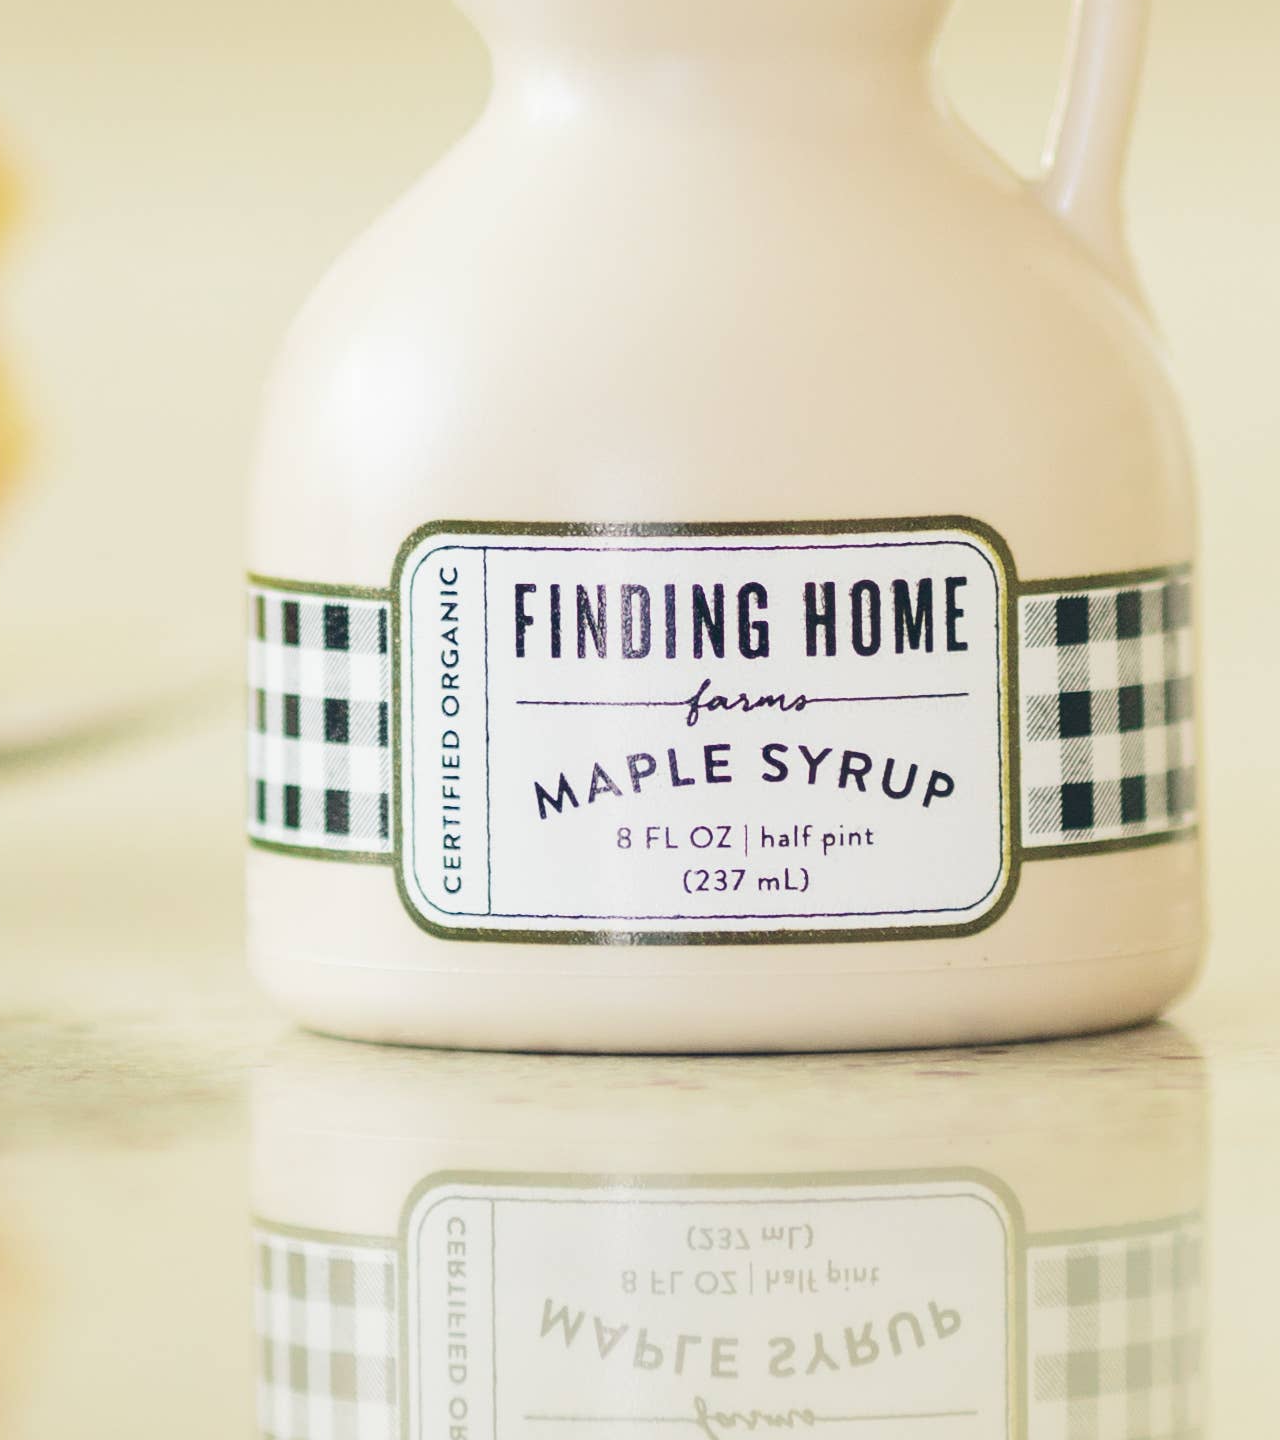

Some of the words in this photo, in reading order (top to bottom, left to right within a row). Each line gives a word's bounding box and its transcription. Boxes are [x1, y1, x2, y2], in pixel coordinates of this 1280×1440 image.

[440, 568, 459, 717] ORGANIC
[515, 582, 769, 659] FINDING
[804, 576, 968, 656] HOME
[686, 678, 807, 727] farms
[442, 730, 461, 894] CERTIFIED
[534, 744, 732, 819] MAPLE
[762, 743, 954, 807] SYRUP
[617, 827, 631, 848] 8
[646, 827, 678, 849] FL
[690, 826, 731, 848] OZ
[762, 825, 812, 847] half
[822, 824, 875, 856] pint
[683, 869, 745, 893] (237
[758, 868, 809, 892] mL)
